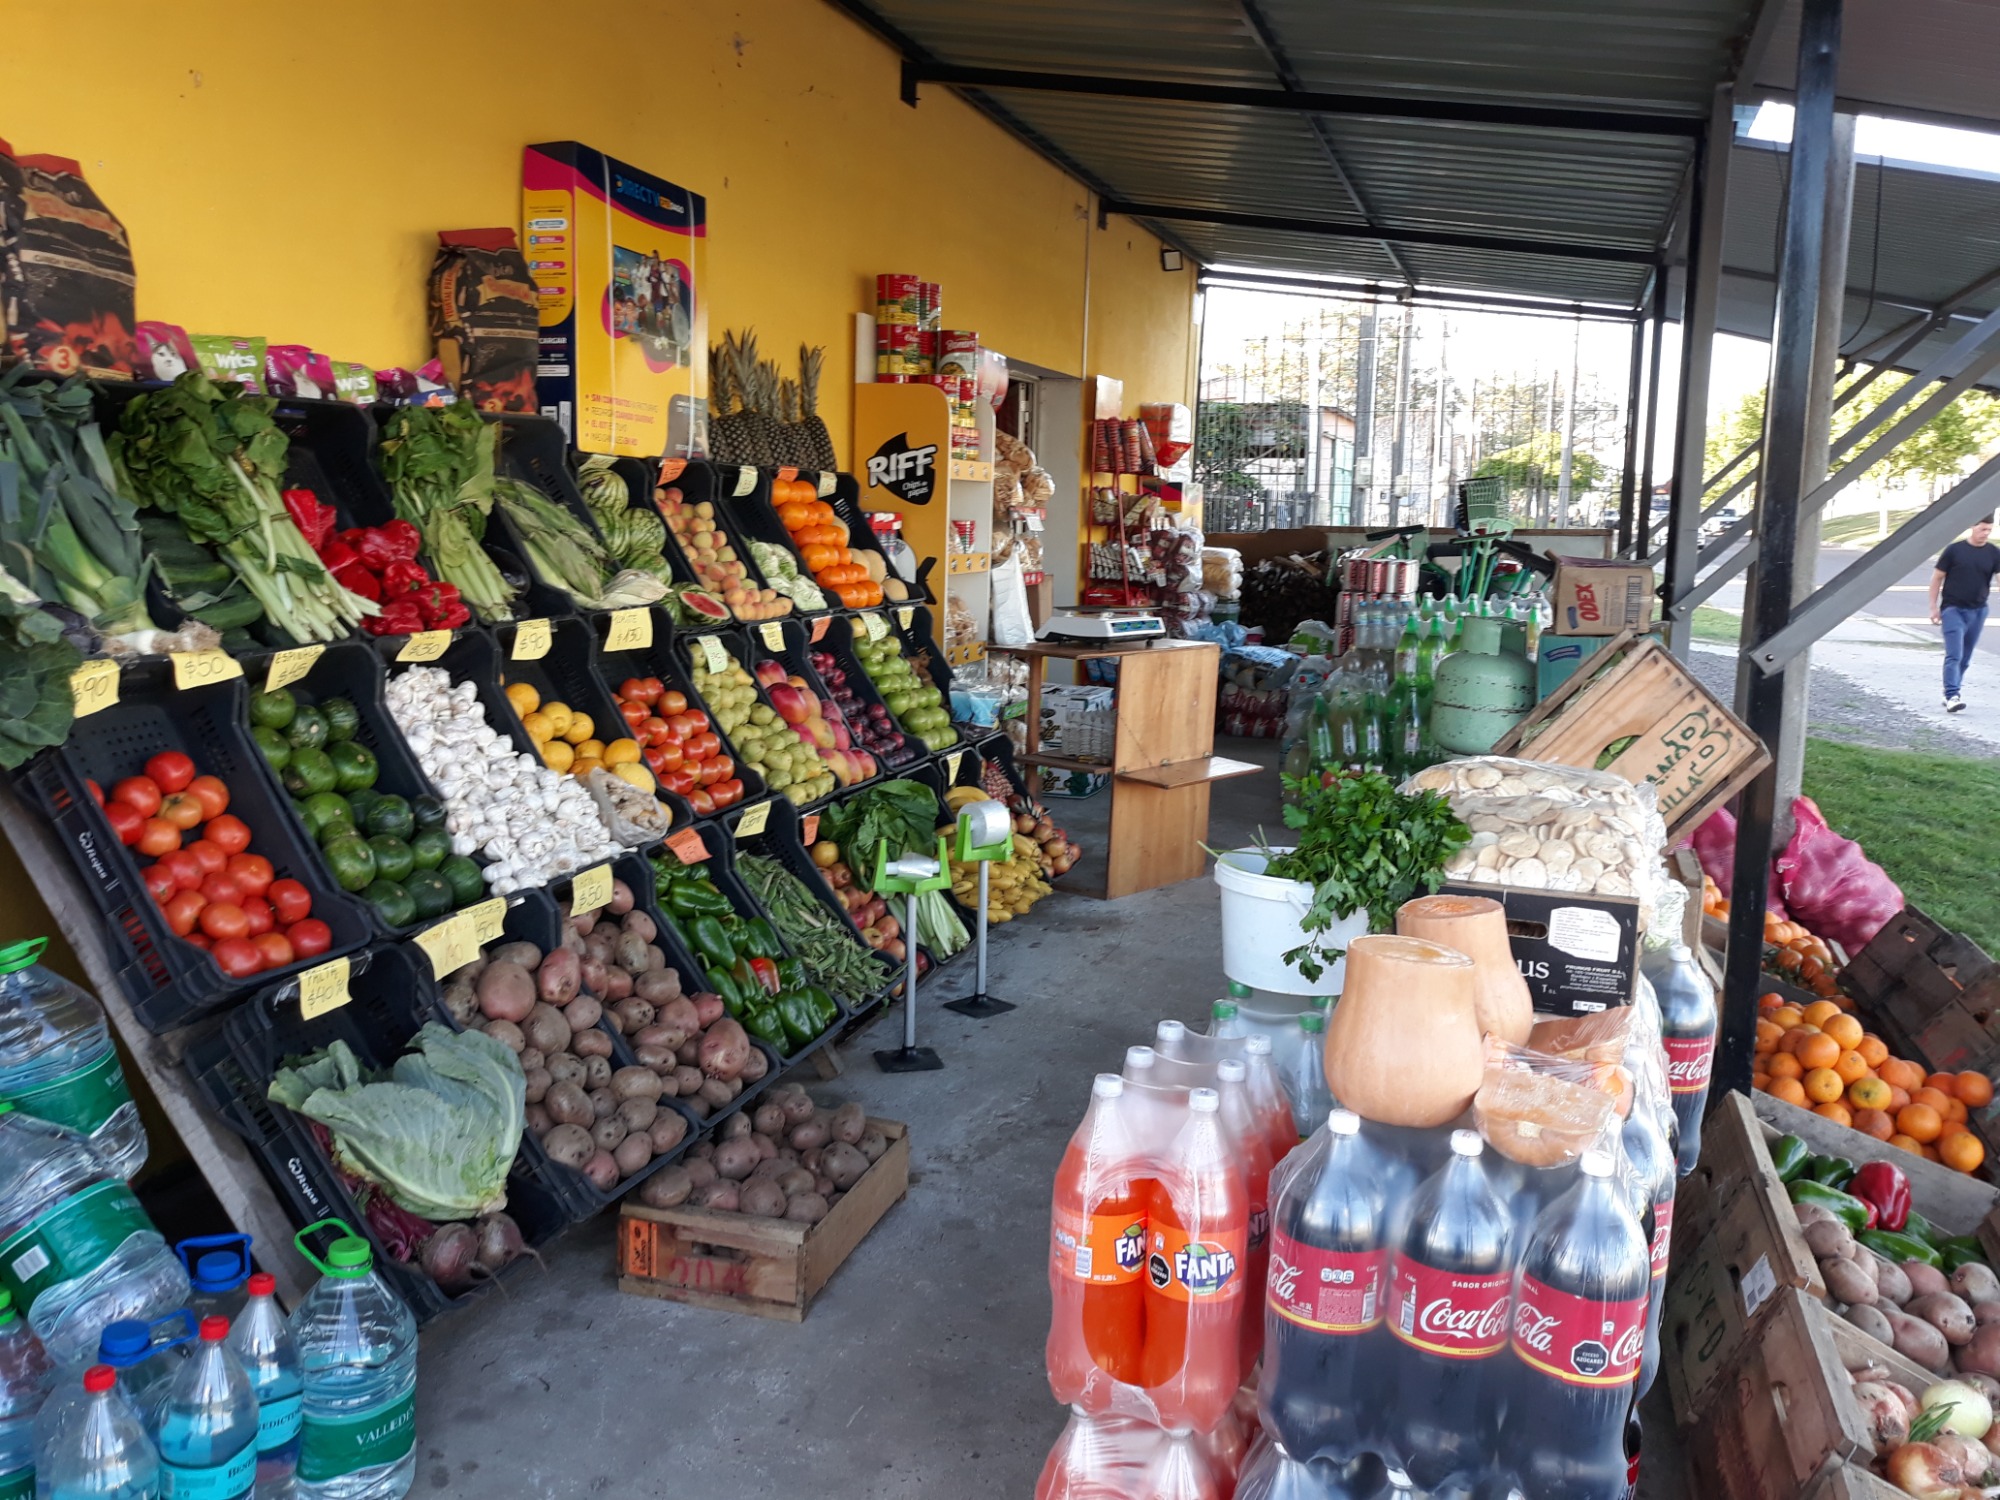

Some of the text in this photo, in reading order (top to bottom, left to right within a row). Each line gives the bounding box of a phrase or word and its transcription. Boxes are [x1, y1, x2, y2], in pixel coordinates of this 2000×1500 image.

[614, 173, 660, 207] DIRECTV
[57, 347, 71, 370] 3
[867, 445, 937, 487] RIFF
[902, 480, 921, 490] Chips
[907, 486, 929, 498] papas
[1574, 583, 1601, 621] ODEX
[1174, 1251, 1236, 1280] FANTA
[1452, 1280, 1481, 1289] SABOR
